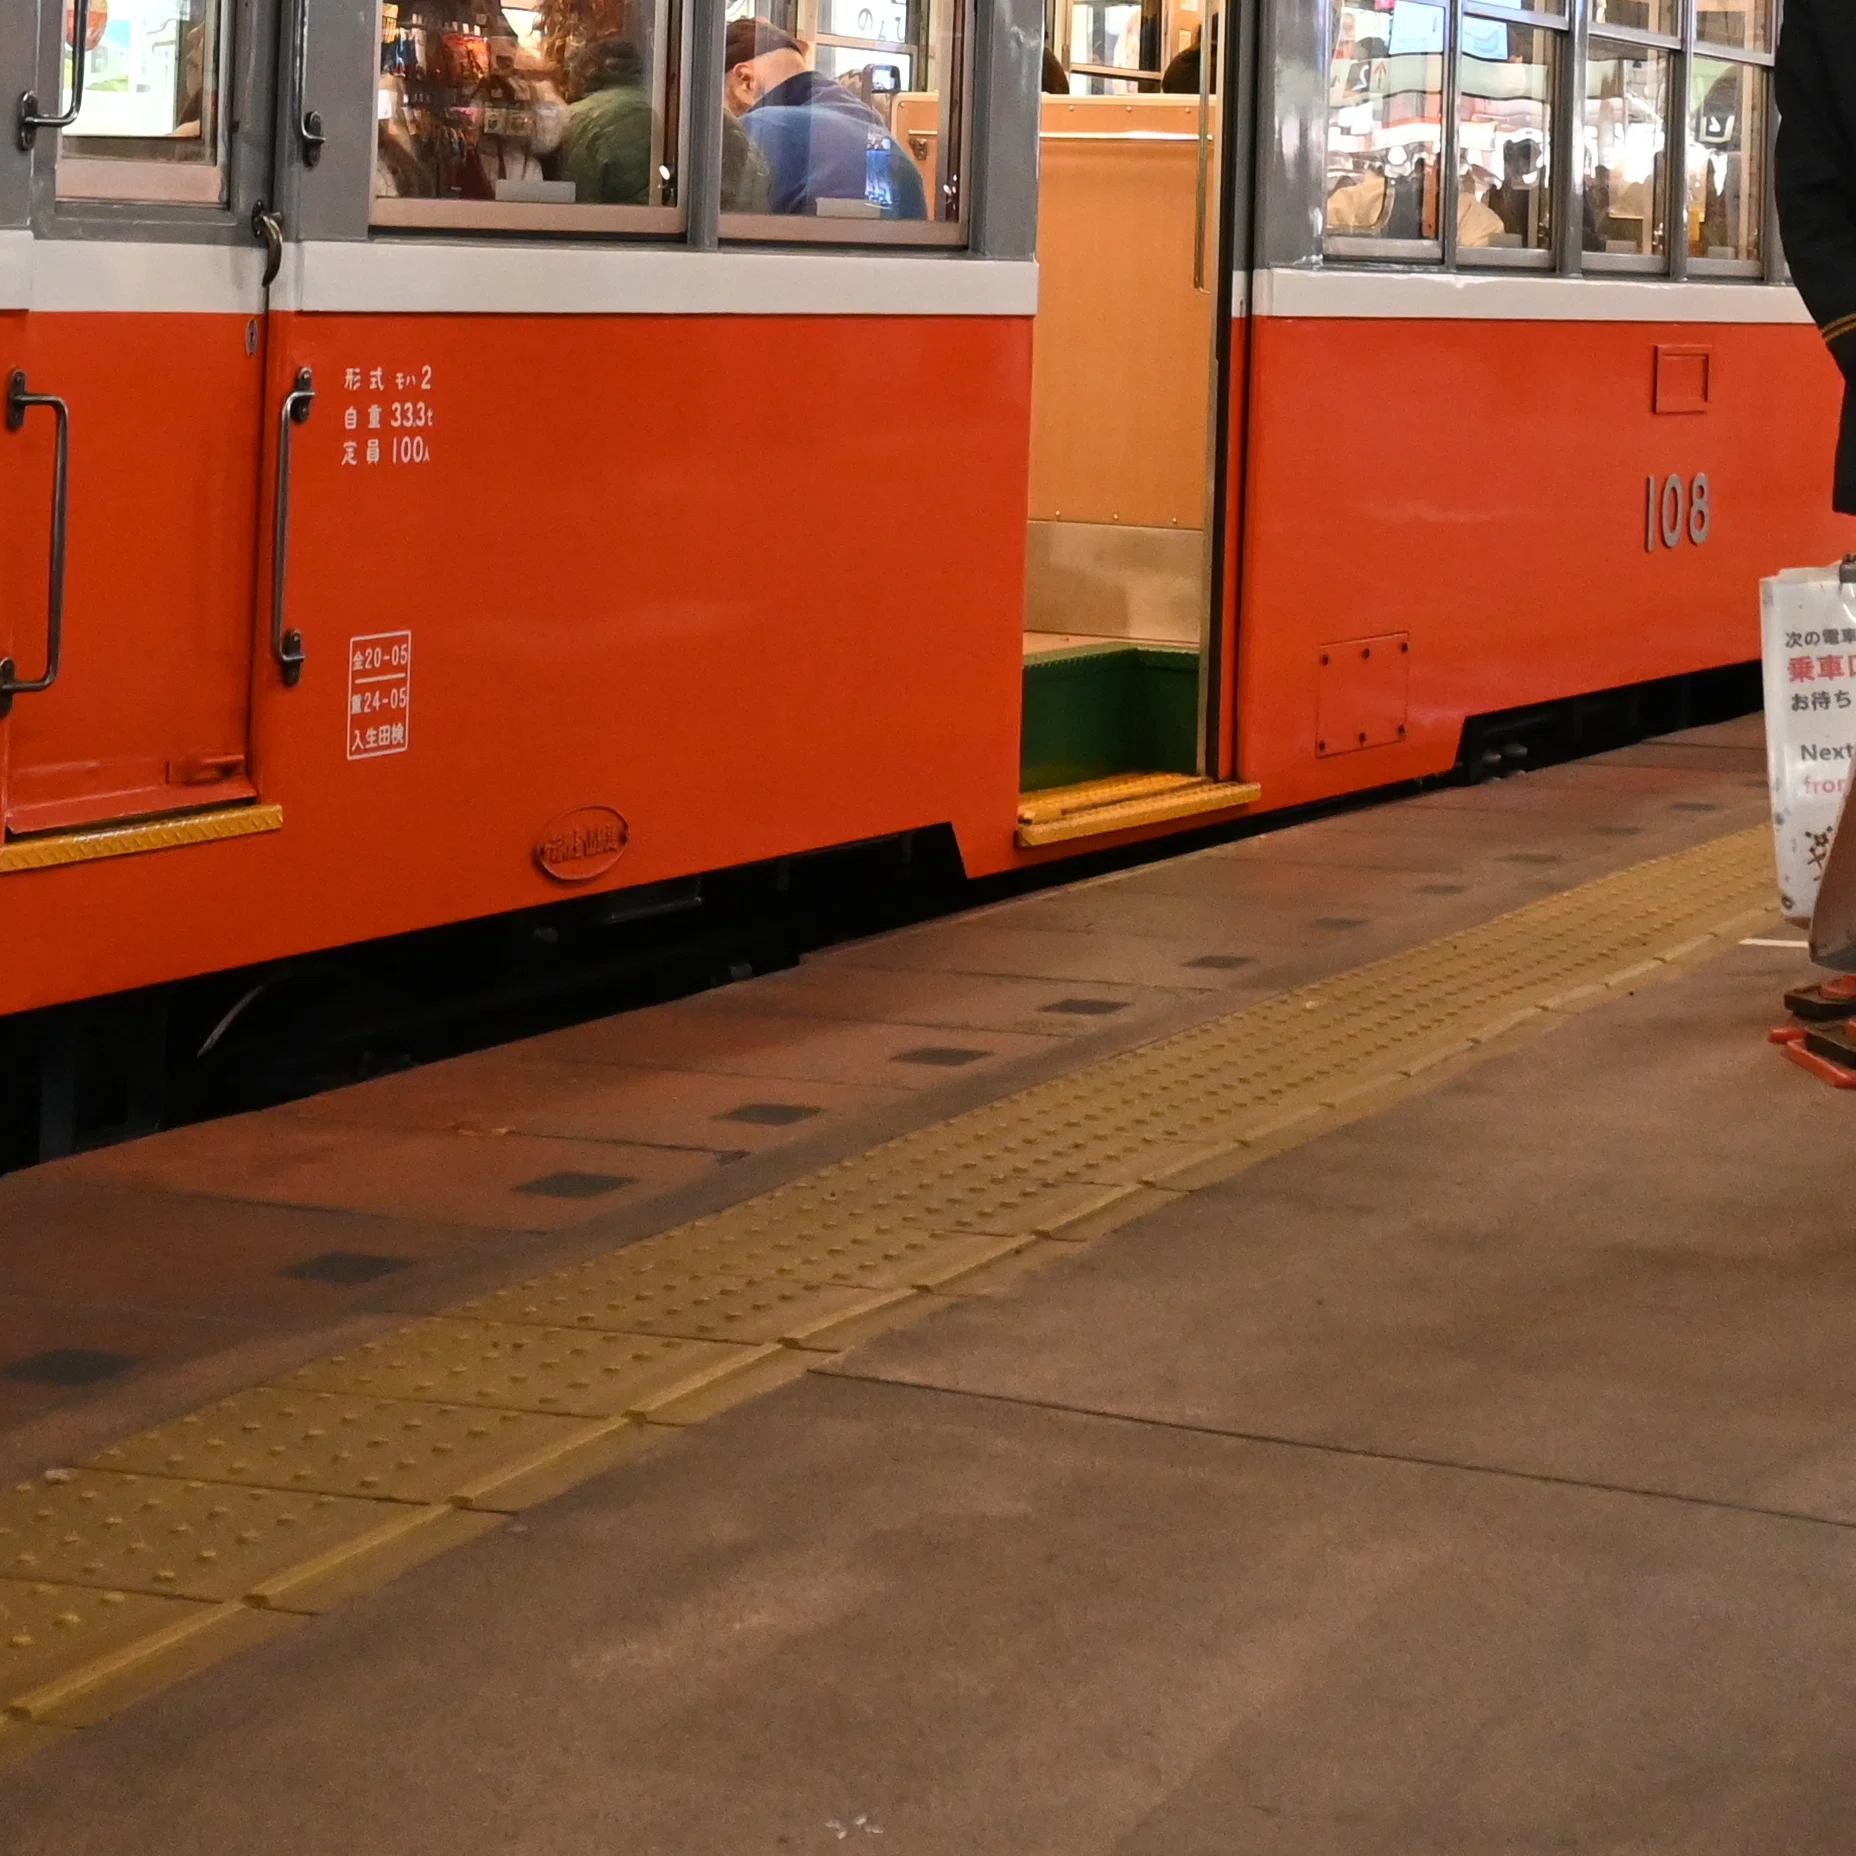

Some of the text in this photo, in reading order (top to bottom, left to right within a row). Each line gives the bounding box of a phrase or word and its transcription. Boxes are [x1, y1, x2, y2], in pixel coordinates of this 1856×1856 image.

[1647, 471, 1711, 552] 108
[351, 722, 405, 752] 入生田検
[1800, 742, 1855, 763] Next
